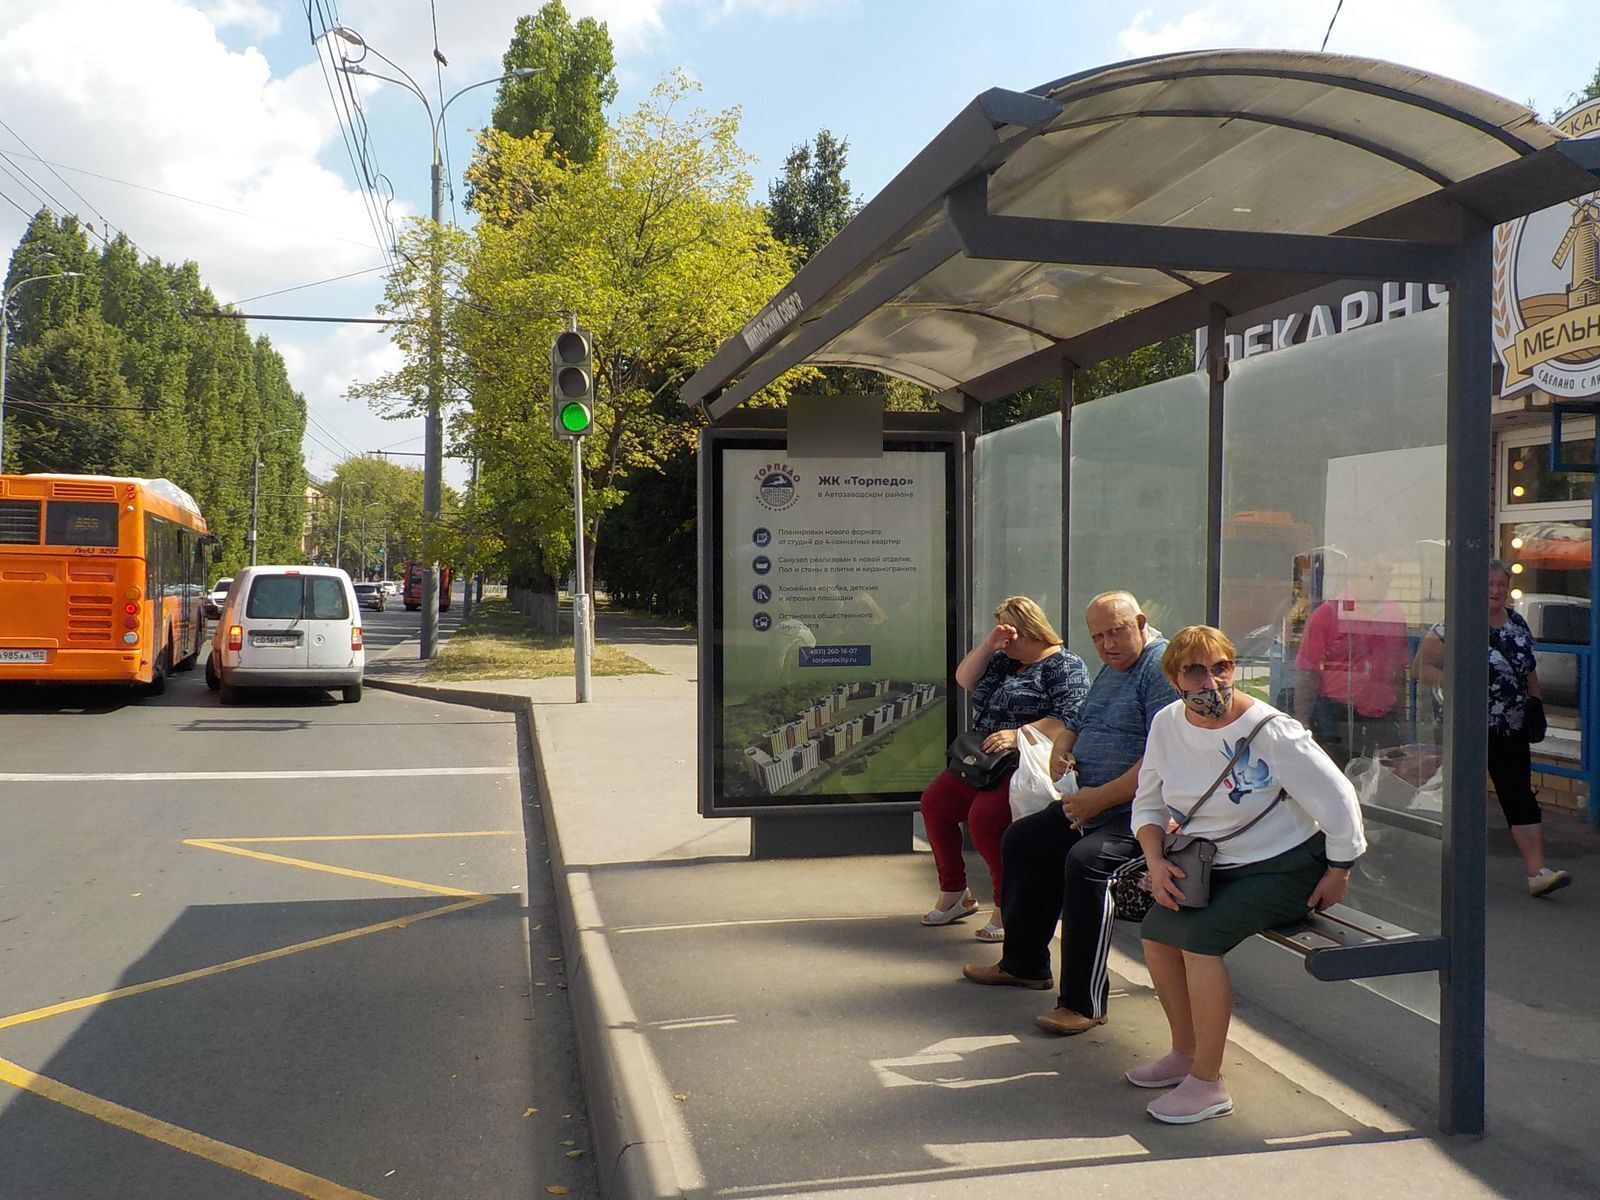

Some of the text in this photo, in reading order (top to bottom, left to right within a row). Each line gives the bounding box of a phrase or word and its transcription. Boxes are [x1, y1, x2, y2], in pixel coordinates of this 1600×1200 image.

[777, 291, 804, 322] СОБОР
[1538, 369, 1575, 390] СДЕЛАНО
[754, 463, 801, 482] ТОРПЕДО
[818, 476, 914, 488] ЖК «Торпедо»
[824, 491, 884, 499] Автозаводском
[885, 491, 914, 500] районе
[778, 529, 824, 537] Планировки
